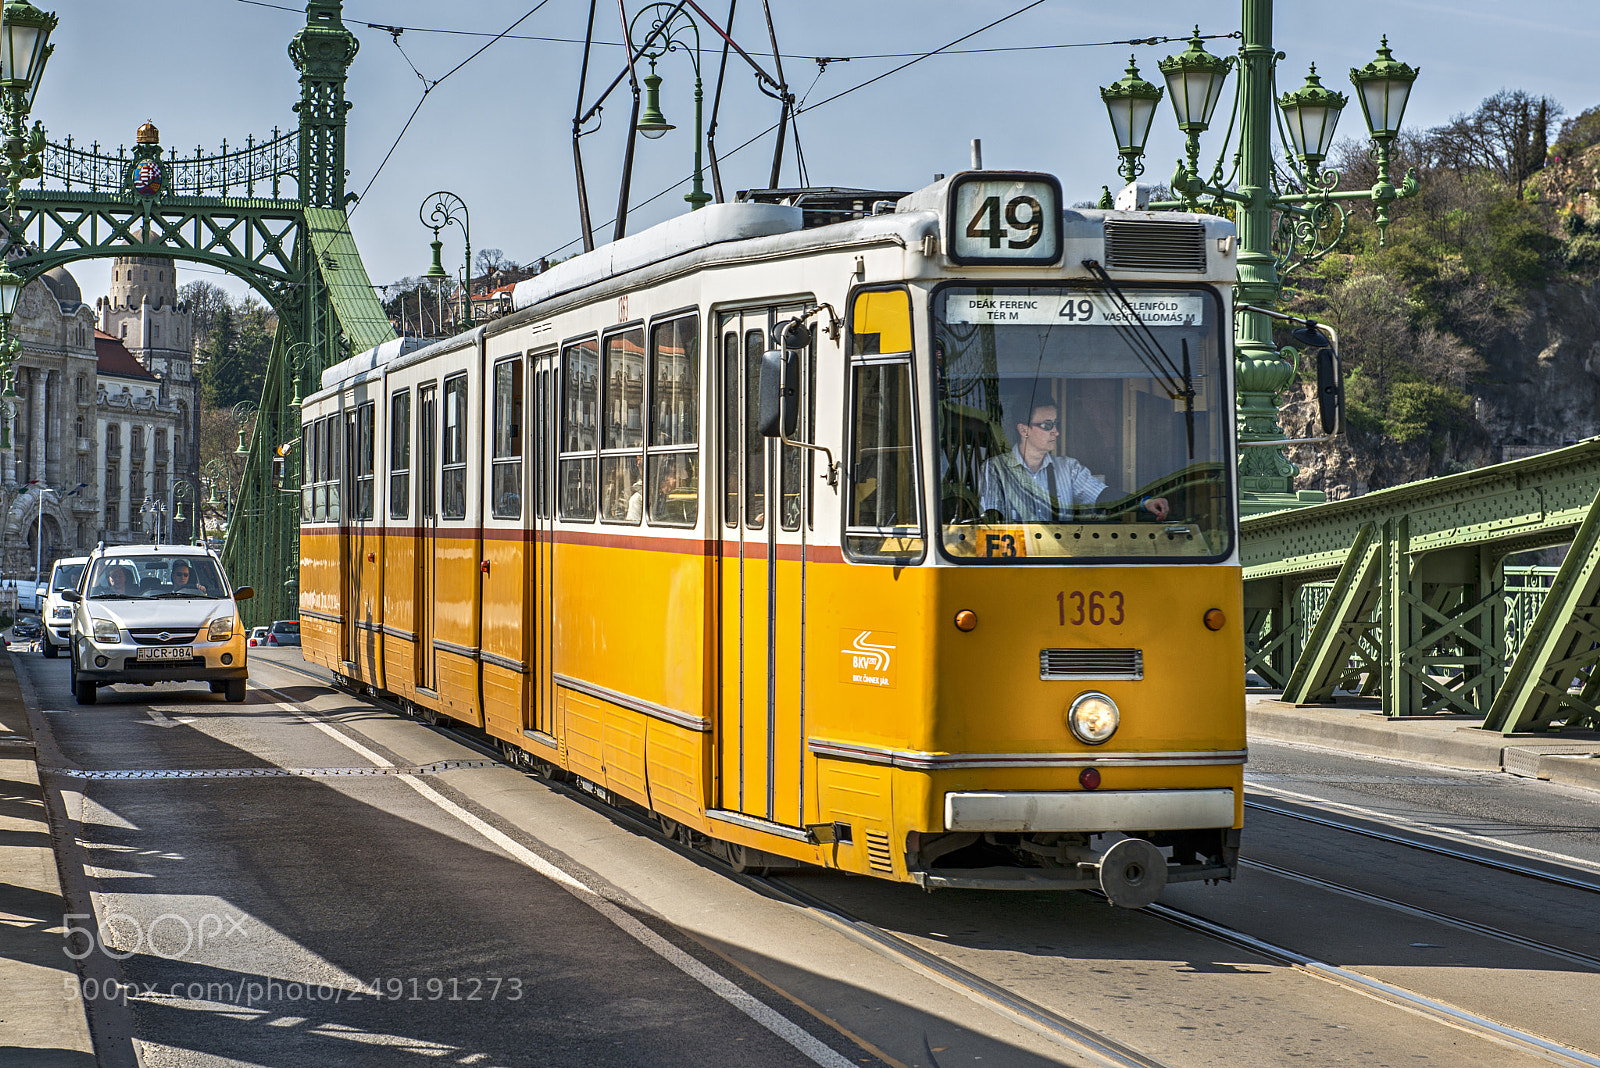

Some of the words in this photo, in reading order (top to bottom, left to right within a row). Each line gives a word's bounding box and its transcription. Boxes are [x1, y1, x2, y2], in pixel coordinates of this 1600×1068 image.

[966, 195, 1044, 250] 49
[969, 298, 997, 309] DEÁK
[999, 300, 1038, 309] FERENC
[1121, 302, 1178, 311] KELENFÖLD
[987, 310, 1006, 320] TÉR
[1009, 312, 1019, 320] M
[1058, 299, 1094, 322] 49
[1102, 311, 1183, 322] VASÚTÁLLOMÁS
[1185, 313, 1196, 322] M
[985, 534, 1016, 557] F3
[1056, 590, 1125, 626] 1363
[146, 648, 191, 658] JCR-084
[852, 655, 869, 670] BKV
